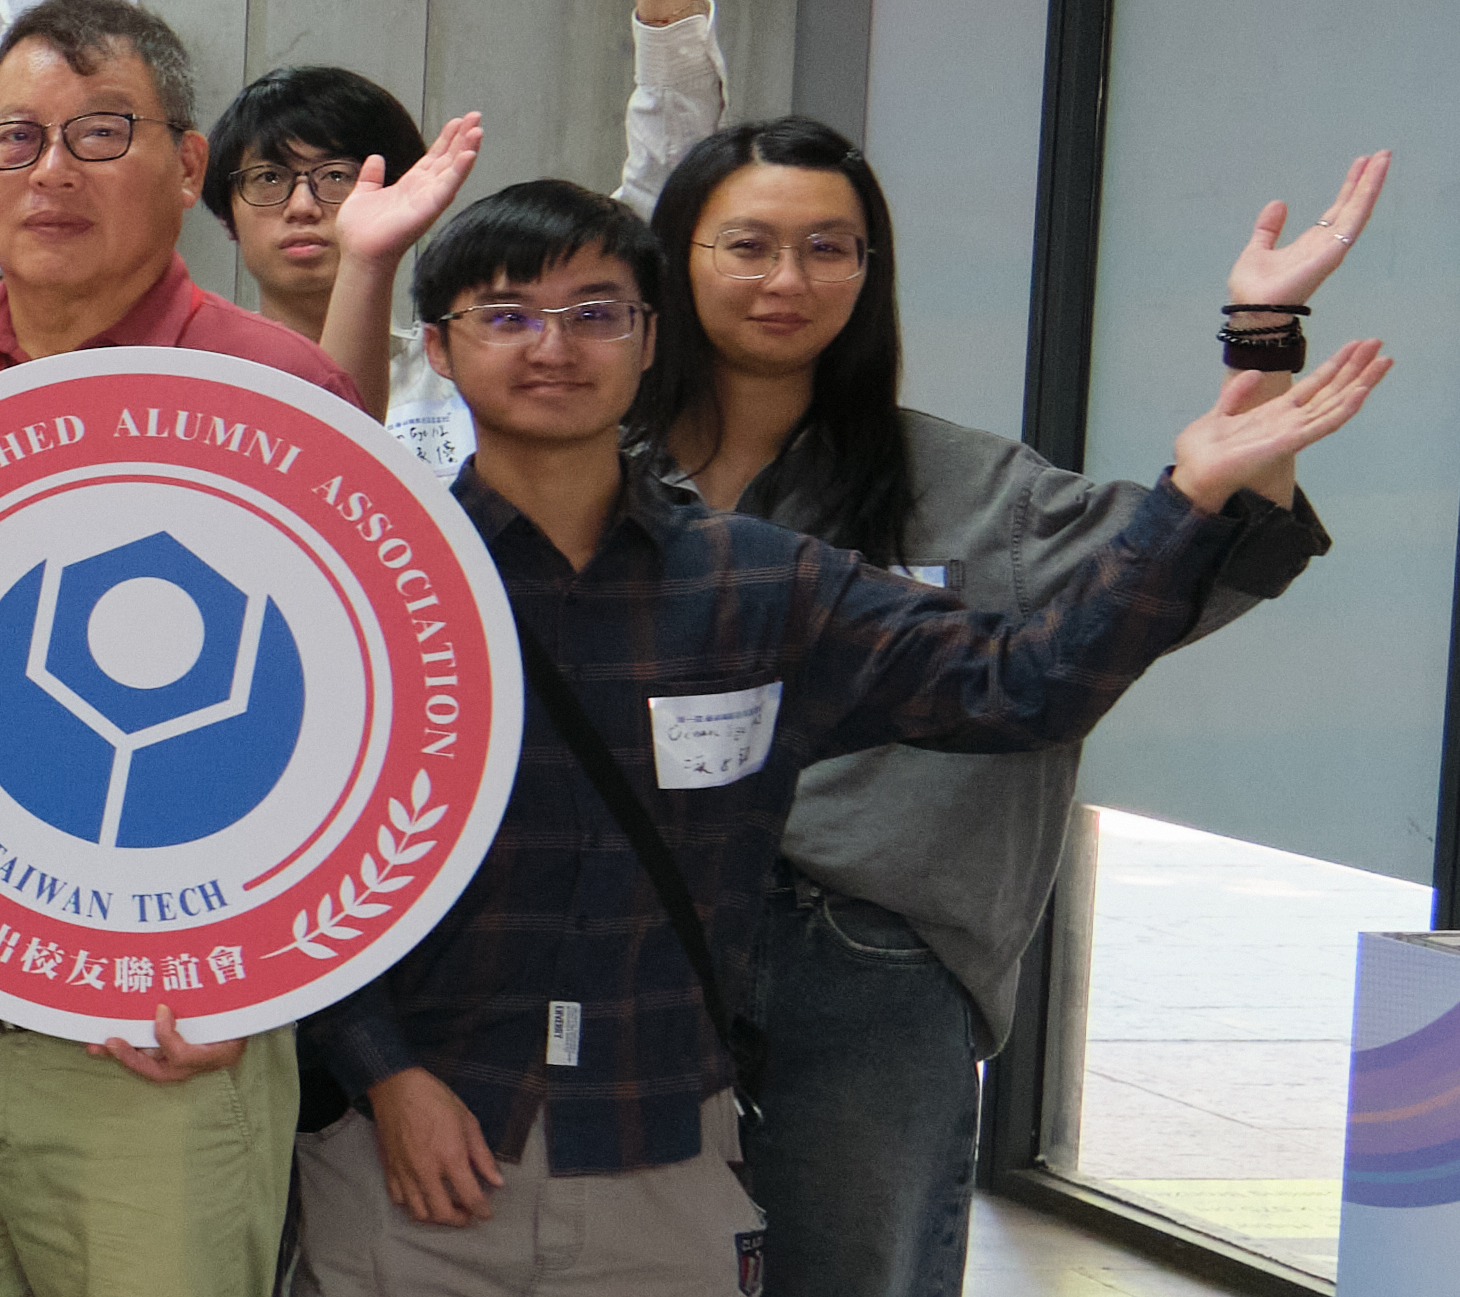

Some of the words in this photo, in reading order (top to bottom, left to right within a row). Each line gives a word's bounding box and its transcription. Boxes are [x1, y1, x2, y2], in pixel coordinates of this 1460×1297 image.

[113, 409, 303, 475] ALUMNI
[311, 476, 459, 759] ASSOCIATION
[131, 877, 228, 923] TECH
